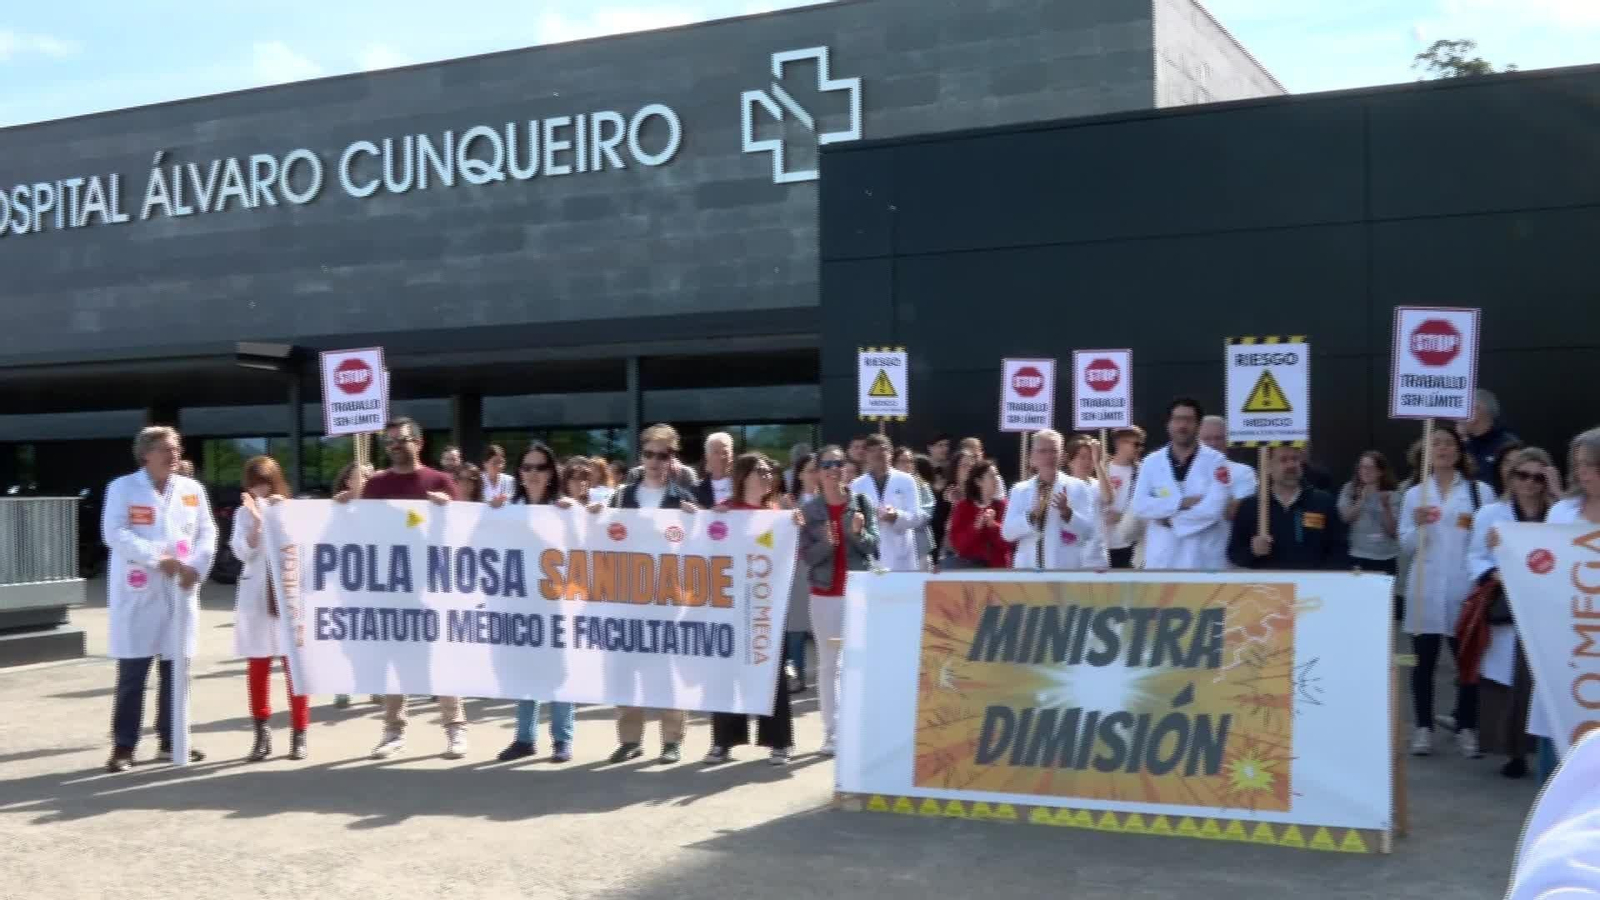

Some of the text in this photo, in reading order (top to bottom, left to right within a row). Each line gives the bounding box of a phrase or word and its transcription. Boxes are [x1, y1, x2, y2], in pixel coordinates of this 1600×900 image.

[0, 103, 682, 235] SPITAL ÁLVARO CUNQUEIRO
[1413, 333, 1459, 352] STOP
[863, 356, 902, 367] RIESGO
[1234, 352, 1299, 367] RIESGO
[337, 369, 369, 385] STOP
[1012, 375, 1042, 388] STOP
[1087, 368, 1119, 381] STOP
[1400, 374, 1467, 389] TRABALLO
[331, 398, 380, 412] TRABALLO
[1006, 401, 1049, 413] TRABALLO
[1079, 397, 1127, 408] TRABALLO
[313, 542, 413, 593] POLA
[427, 544, 529, 598] NOSA
[539, 548, 734, 609] SANIDADE
[313, 606, 440, 642] ESTATUTO
[446, 602, 543, 648] MÉDICO
[549, 614, 567, 649] E
[572, 614, 735, 659] FACULTATIVO
[968, 604, 1227, 669] MINISTRA
[974, 682, 1232, 778] DIMISIÓN
